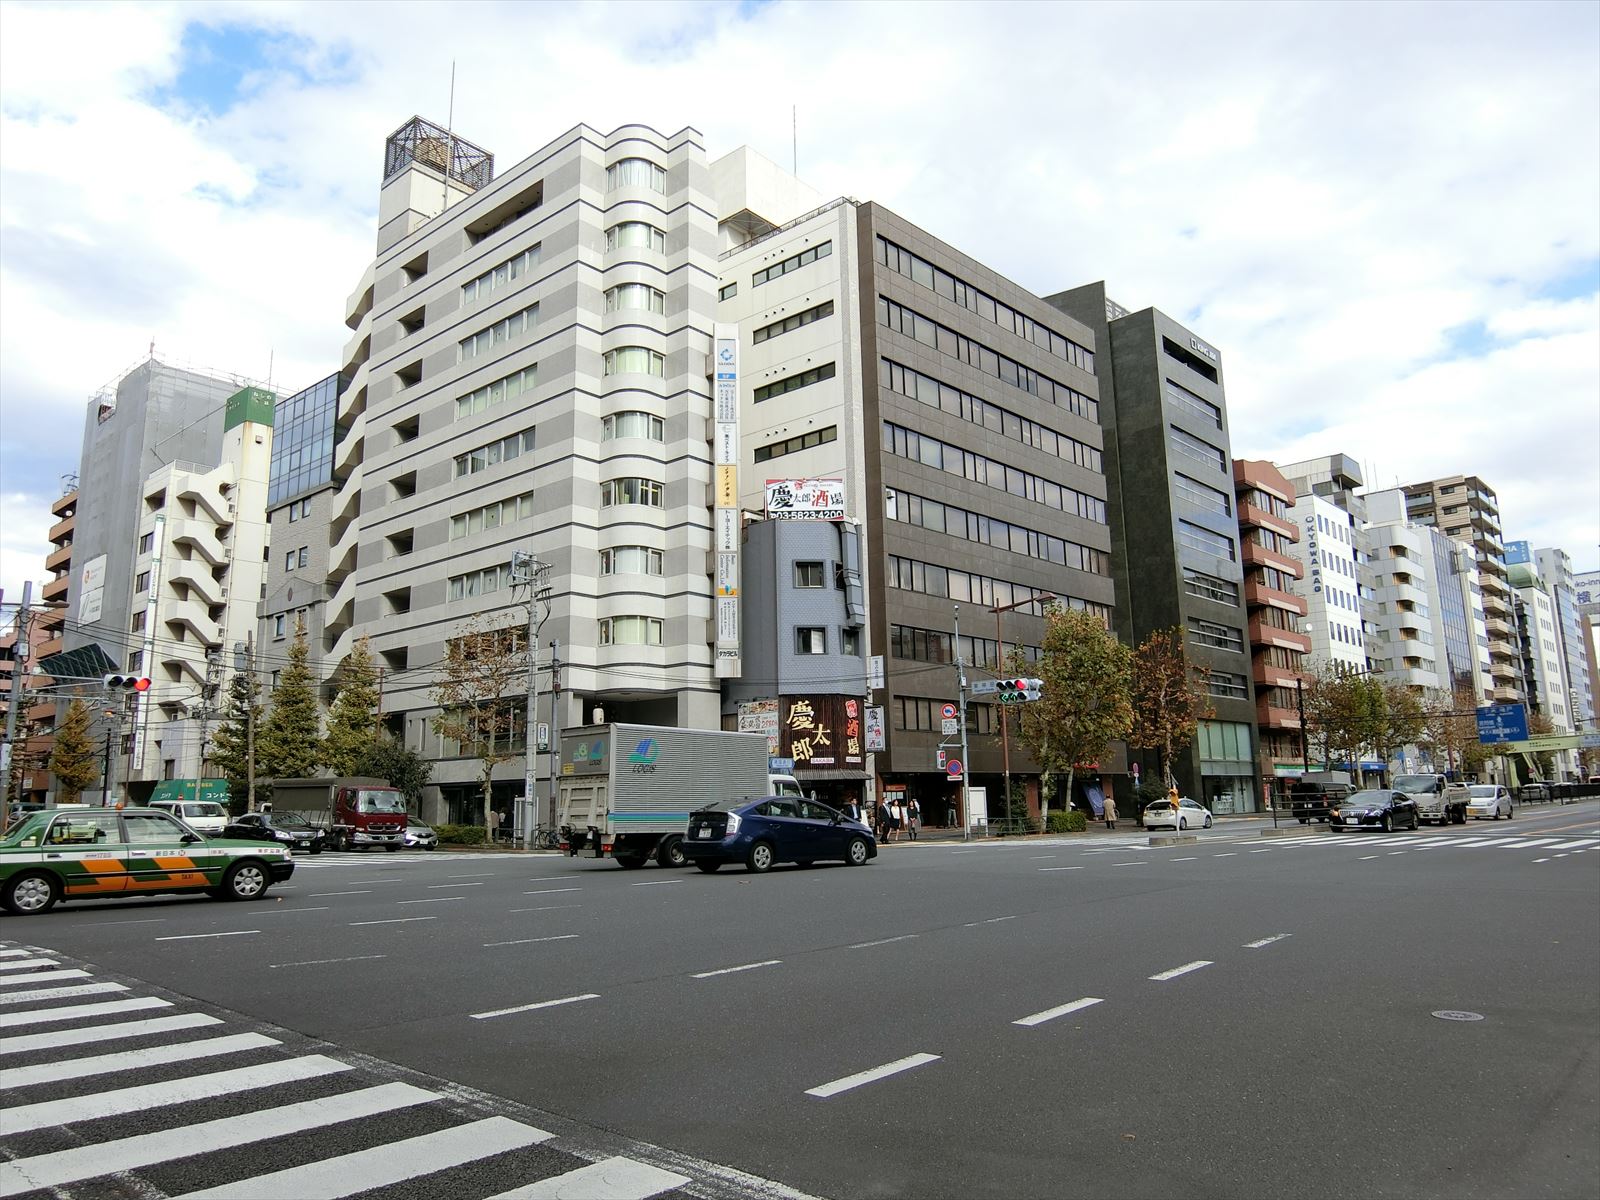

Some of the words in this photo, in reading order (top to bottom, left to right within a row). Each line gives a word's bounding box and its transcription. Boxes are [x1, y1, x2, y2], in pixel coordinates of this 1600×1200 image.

[769, 485, 843, 509] 慶太郎酒場
[776, 511, 843, 519] 03-5823-4200
[786, 700, 831, 761] 慶太郎
